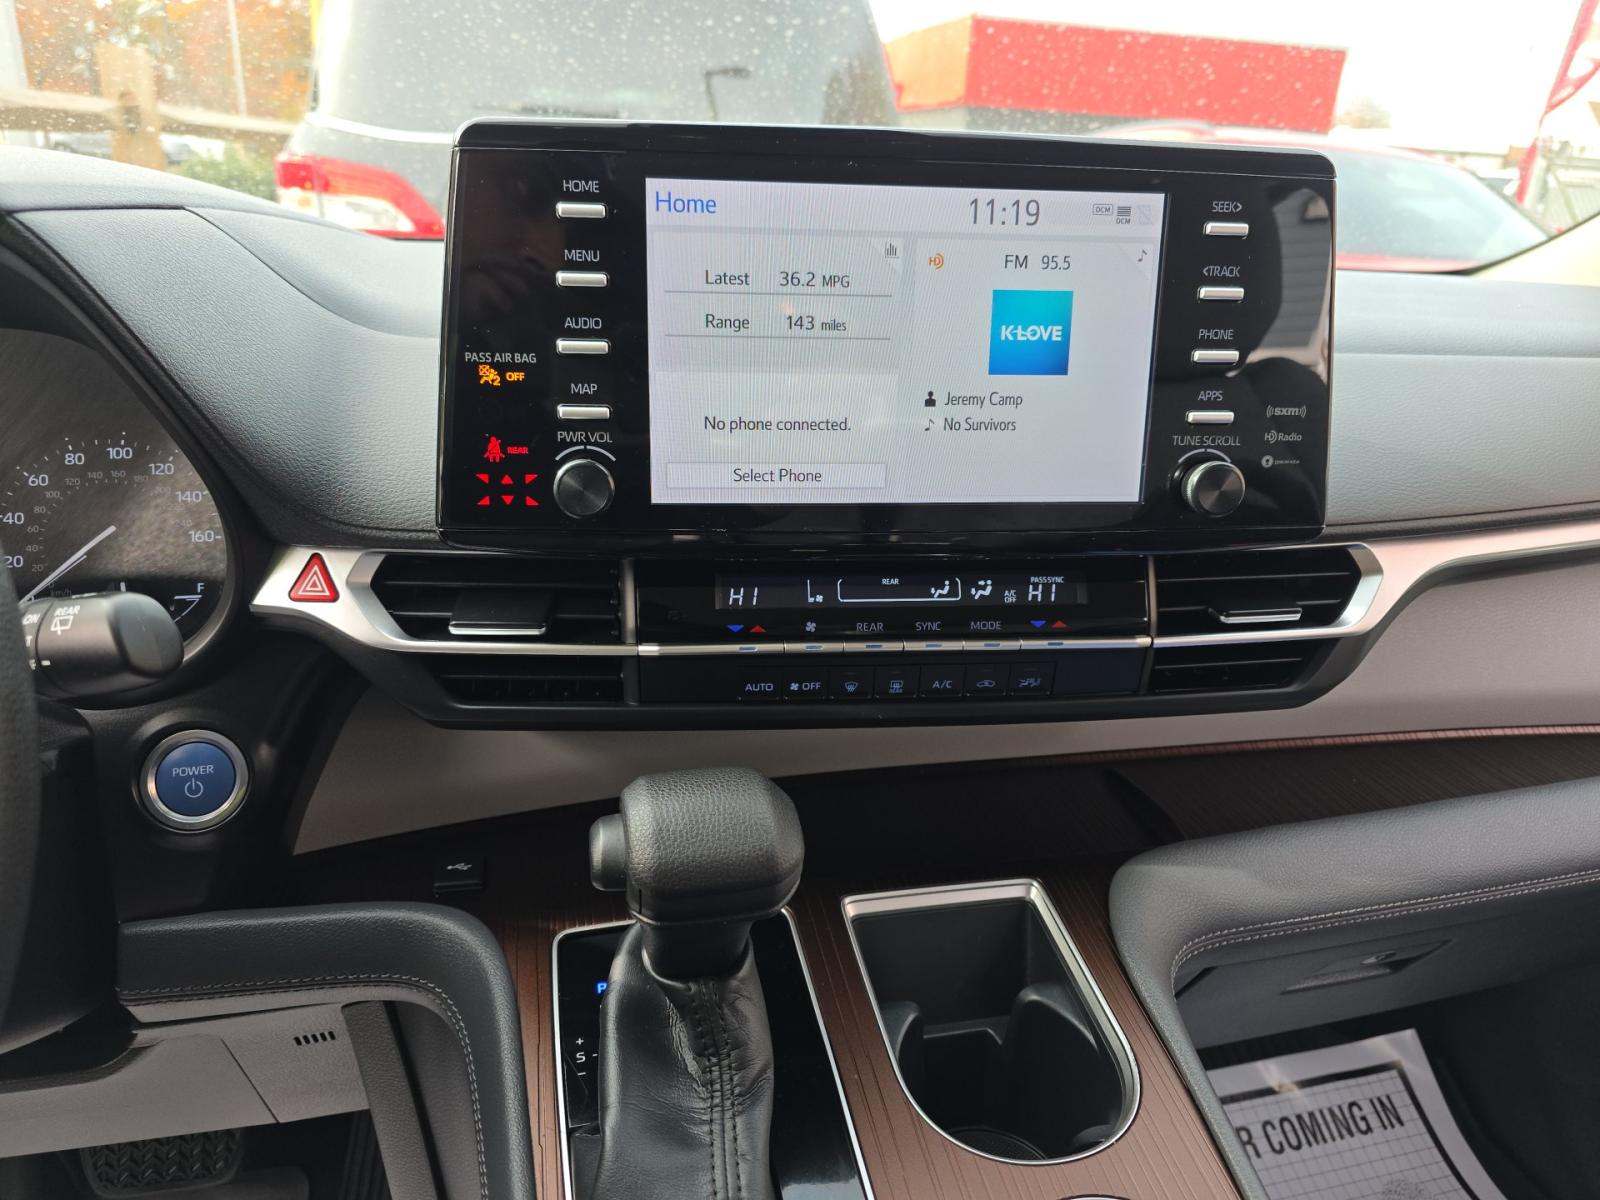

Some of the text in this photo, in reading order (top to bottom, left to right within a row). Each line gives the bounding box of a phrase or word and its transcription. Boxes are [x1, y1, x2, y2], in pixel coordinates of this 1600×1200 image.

[563, 179, 600, 193] HOME
[655, 191, 717, 214] Home
[969, 198, 1040, 226] 11:19
[564, 249, 600, 262] MENU
[1004, 255, 1071, 271] FM 95.5
[705, 269, 850, 289] Latest 36.2 MPG
[564, 317, 603, 330] AUDIO
[705, 314, 847, 332] Range 143 miles
[1198, 328, 1234, 340] PHONE
[465, 352, 537, 364] PASS AIR BAG
[505, 372, 526, 382] OFF
[570, 383, 598, 395] MAP
[944, 391, 1023, 409] Jeremy Camp
[1197, 390, 1224, 401] APPS
[704, 415, 852, 433] No phone connected.
[943, 416, 1017, 431] No Survivors
[557, 431, 613, 443] PWR VOL
[1173, 435, 1241, 446] TUNE SCROLL
[106, 447, 133, 459] 100
[506, 446, 529, 454] REAR
[65, 453, 85, 465] 80
[149, 464, 174, 475] 120
[733, 468, 822, 482] Select Phone
[28, 474, 48, 486] 60
[175, 491, 202, 502] 140
[3, 512, 25, 525] 40
[188, 531, 214, 543] 160
[4, 556, 24, 568] 20
[196, 582, 205, 592] F
[881, 577, 900, 586] REAR
[1004, 596, 1017, 604] OFF
[54, 605, 81, 617] REAR
[856, 622, 884, 632] REAR
[915, 621, 942, 631] SYNC
[970, 620, 1003, 631] MODE
[745, 682, 774, 692] AUTO
[802, 682, 823, 691] OFF
[932, 679, 953, 689] A/C
[172, 764, 214, 778] POWER
[597, 983, 607, 993] P
[576, 1052, 586, 1062] S
[1262, 1101, 1373, 1155] COMING
[1369, 1094, 1405, 1131] IN
